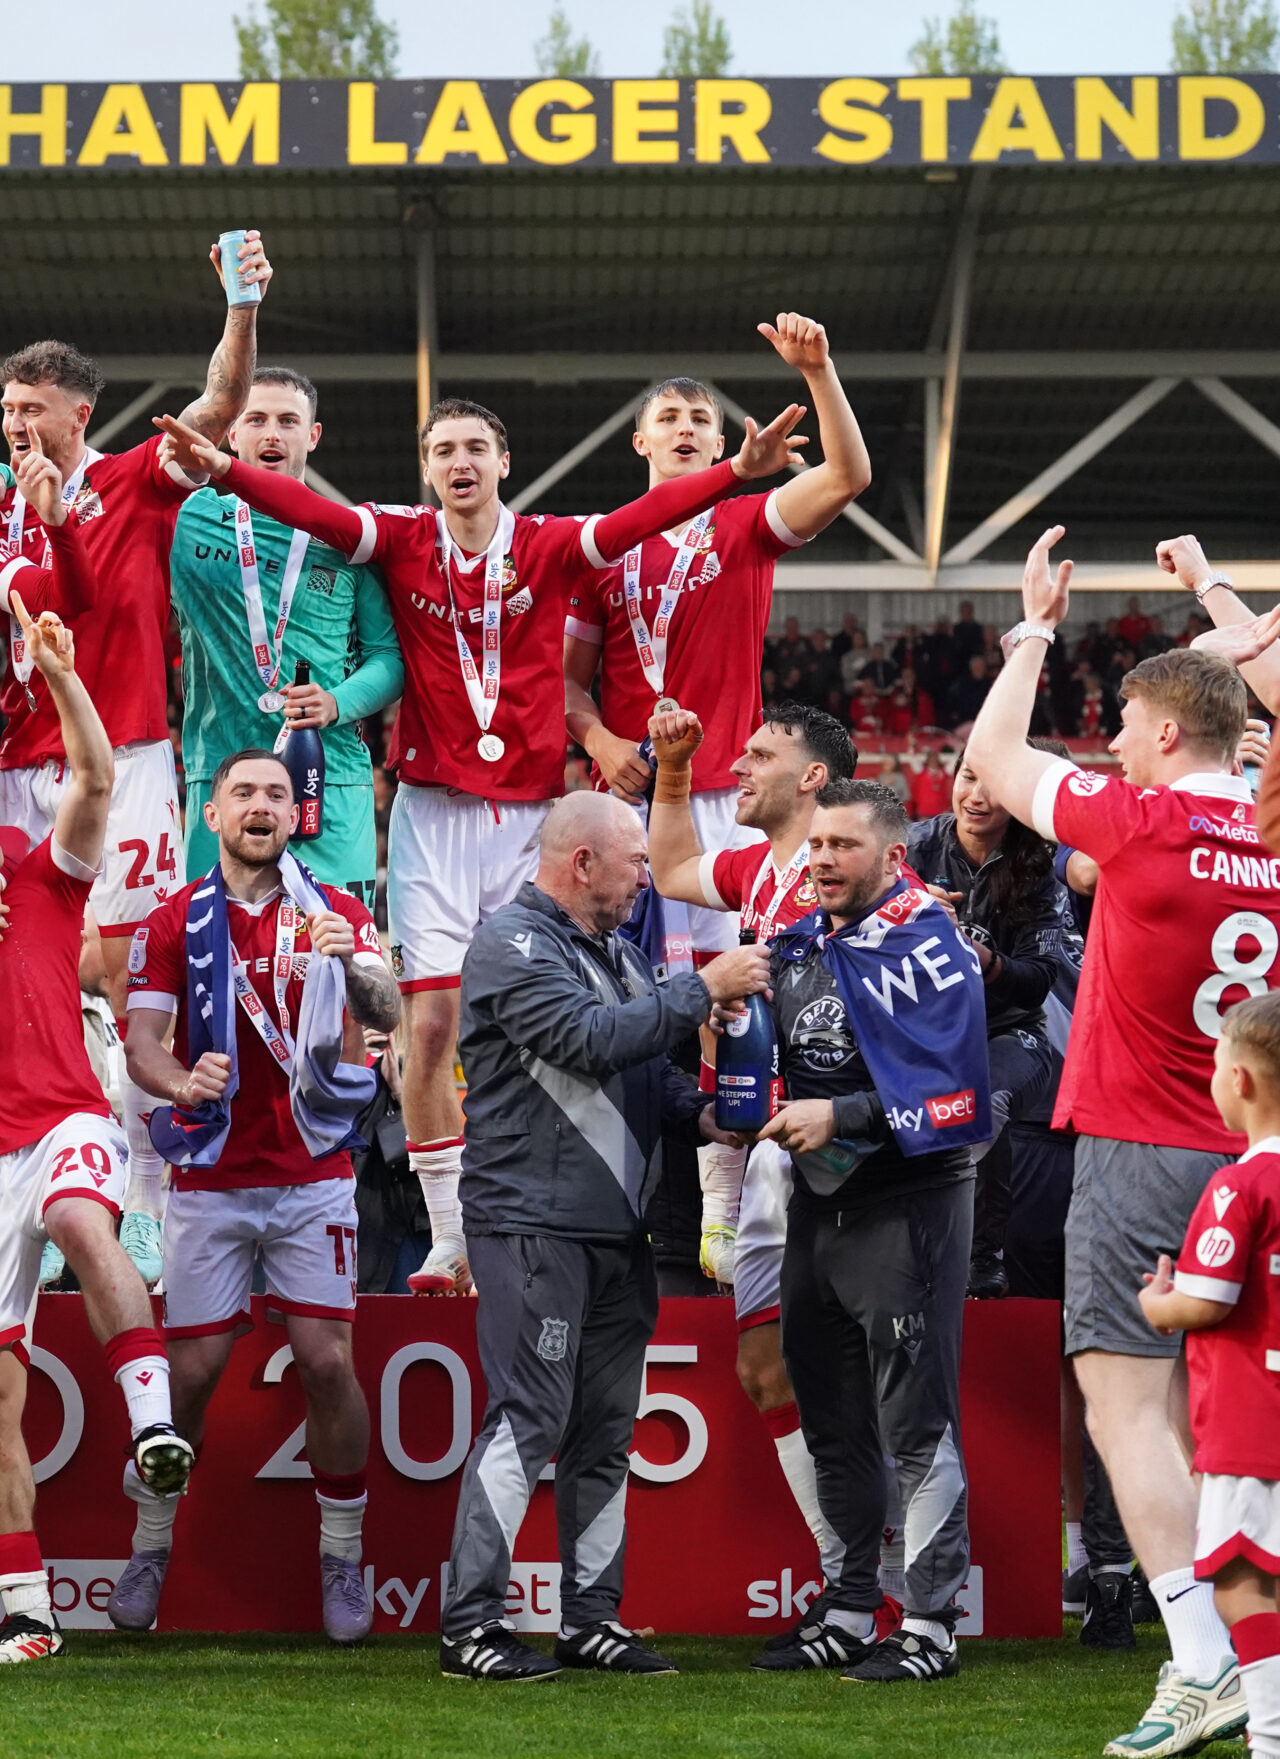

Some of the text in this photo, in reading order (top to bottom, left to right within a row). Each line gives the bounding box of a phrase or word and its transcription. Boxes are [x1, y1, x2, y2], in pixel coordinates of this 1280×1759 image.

[348, 78, 772, 165] LAGER
[816, 75, 1265, 164] STAND
[62, 484, 75, 503] sky
[10, 522, 21, 540] sky
[240, 530, 254, 567] sky bet
[686, 516, 706, 547] sky bet
[488, 562, 500, 600] sky bet
[627, 554, 638, 571] bet
[671, 554, 689, 590] sky bet
[279, 600, 289, 618] sky
[626, 580, 639, 619] sky bet
[658, 599, 673, 637] sky bet
[488, 630, 498, 650] bet
[638, 627, 653, 666] sky bet
[256, 645, 272, 685] sky bet
[460, 641, 476, 680] sky bet
[485, 660, 498, 699] sky bet
[304, 768, 320, 831] sky bet
[1213, 822, 1260, 844] Meta
[118, 832, 176, 890] 24
[782, 851, 808, 889] sky bet
[281, 908, 293, 926] bet
[761, 898, 779, 939] sky bet
[277, 936, 291, 977] sky bet
[1193, 911, 1278, 1040] 8
[235, 976, 261, 1015] sky bet
[862, 936, 965, 1017] WE
[276, 987, 289, 1029] sky bet
[802, 1000, 846, 1026] BETTY
[261, 1022, 288, 1060] sky bet
[726, 1091, 757, 1099] STEPPED
[771, 1043, 780, 1115] sky bet
[728, 1099, 741, 1107] UP!
[932, 1095, 973, 1120] bet
[51, 1142, 111, 1183] 20
[1201, 1227, 1231, 1267] hp
[892, 1311, 926, 1339] KM
[255, 1342, 708, 1483] 205
[50, 1568, 116, 1613] be
[364, 1565, 552, 1628] ky et
[747, 1567, 822, 1618] sk
